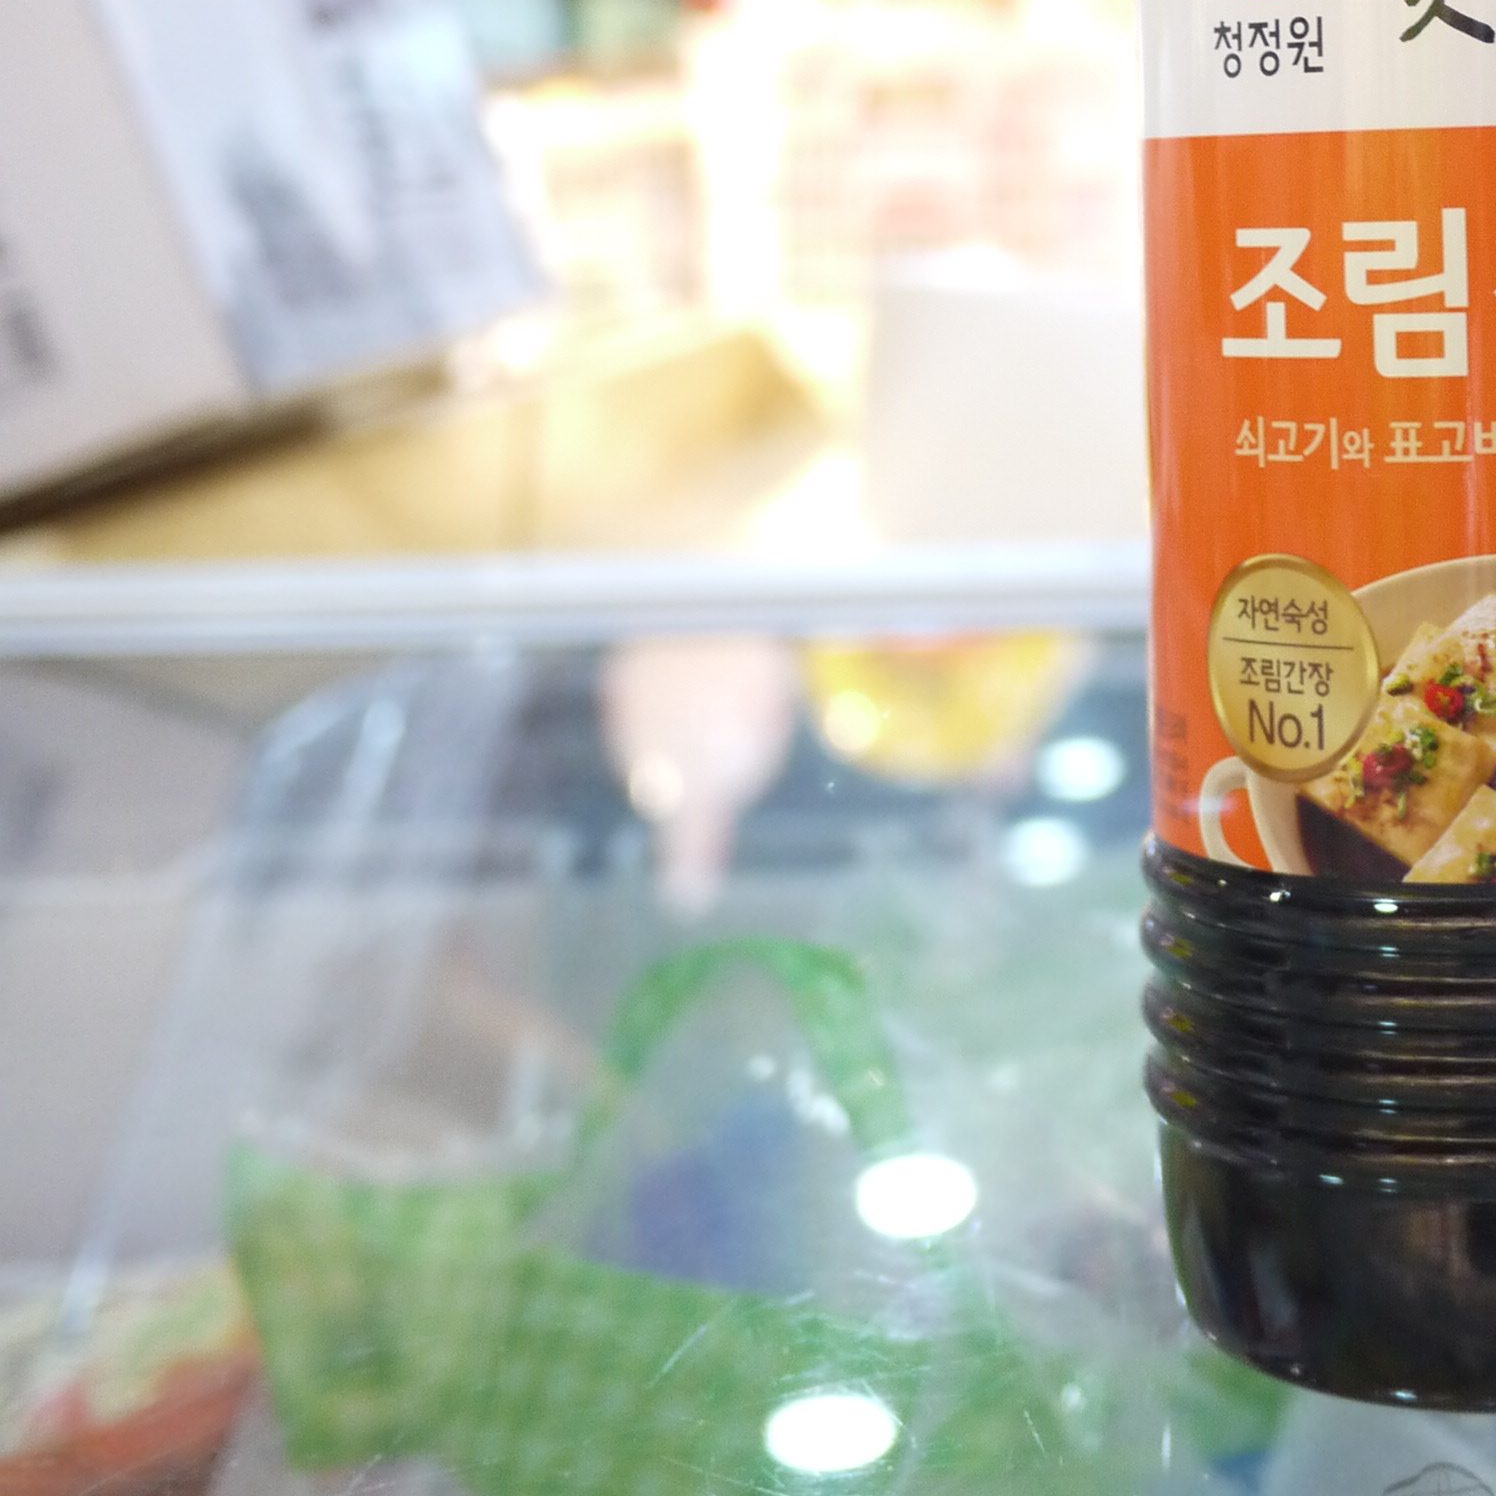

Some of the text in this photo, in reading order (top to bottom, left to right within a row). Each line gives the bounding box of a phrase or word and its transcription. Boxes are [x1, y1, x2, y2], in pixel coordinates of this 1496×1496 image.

[1214, 15, 1324, 79] 청정원
[1235, 415, 1375, 470] 쇠고기와
[1237, 595, 1329, 636] 자연숙성
[1240, 657, 1334, 697] 조림간장
[1248, 699, 1326, 751] No.1
